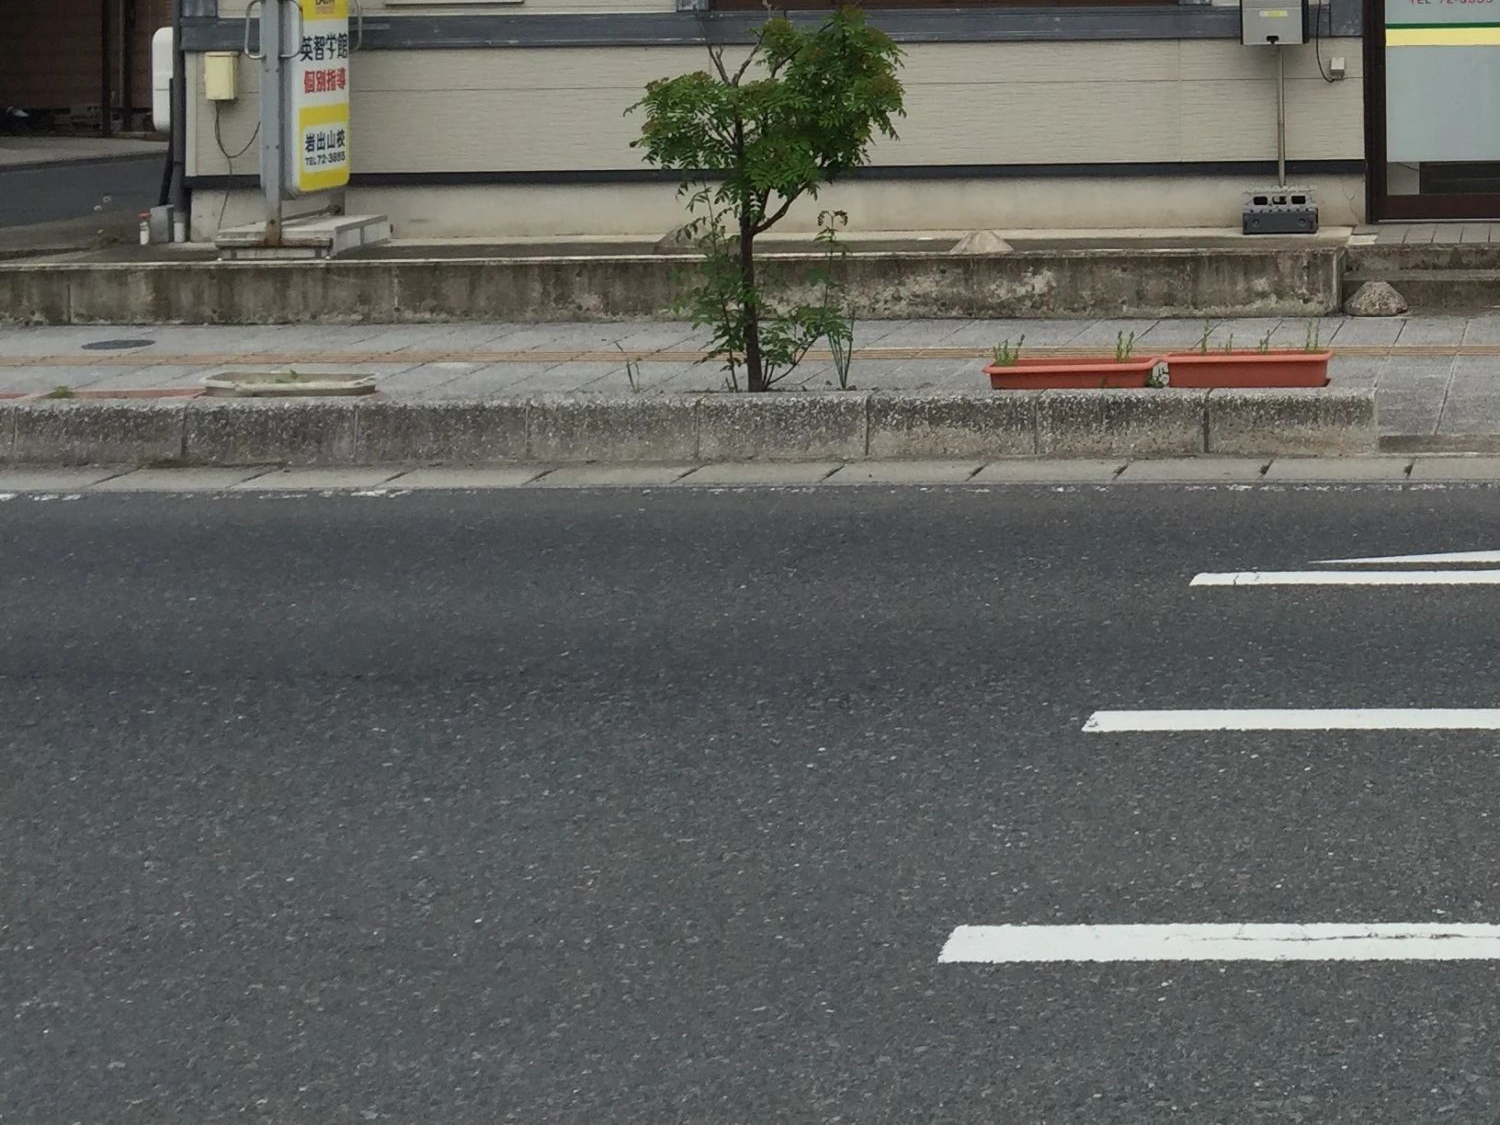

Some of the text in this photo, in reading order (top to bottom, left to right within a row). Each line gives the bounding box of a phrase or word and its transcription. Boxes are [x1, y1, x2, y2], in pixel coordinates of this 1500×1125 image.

[300, 33, 348, 62] 英智学館
[304, 67, 346, 94] 個別指導
[305, 128, 346, 152] 岩出山校
